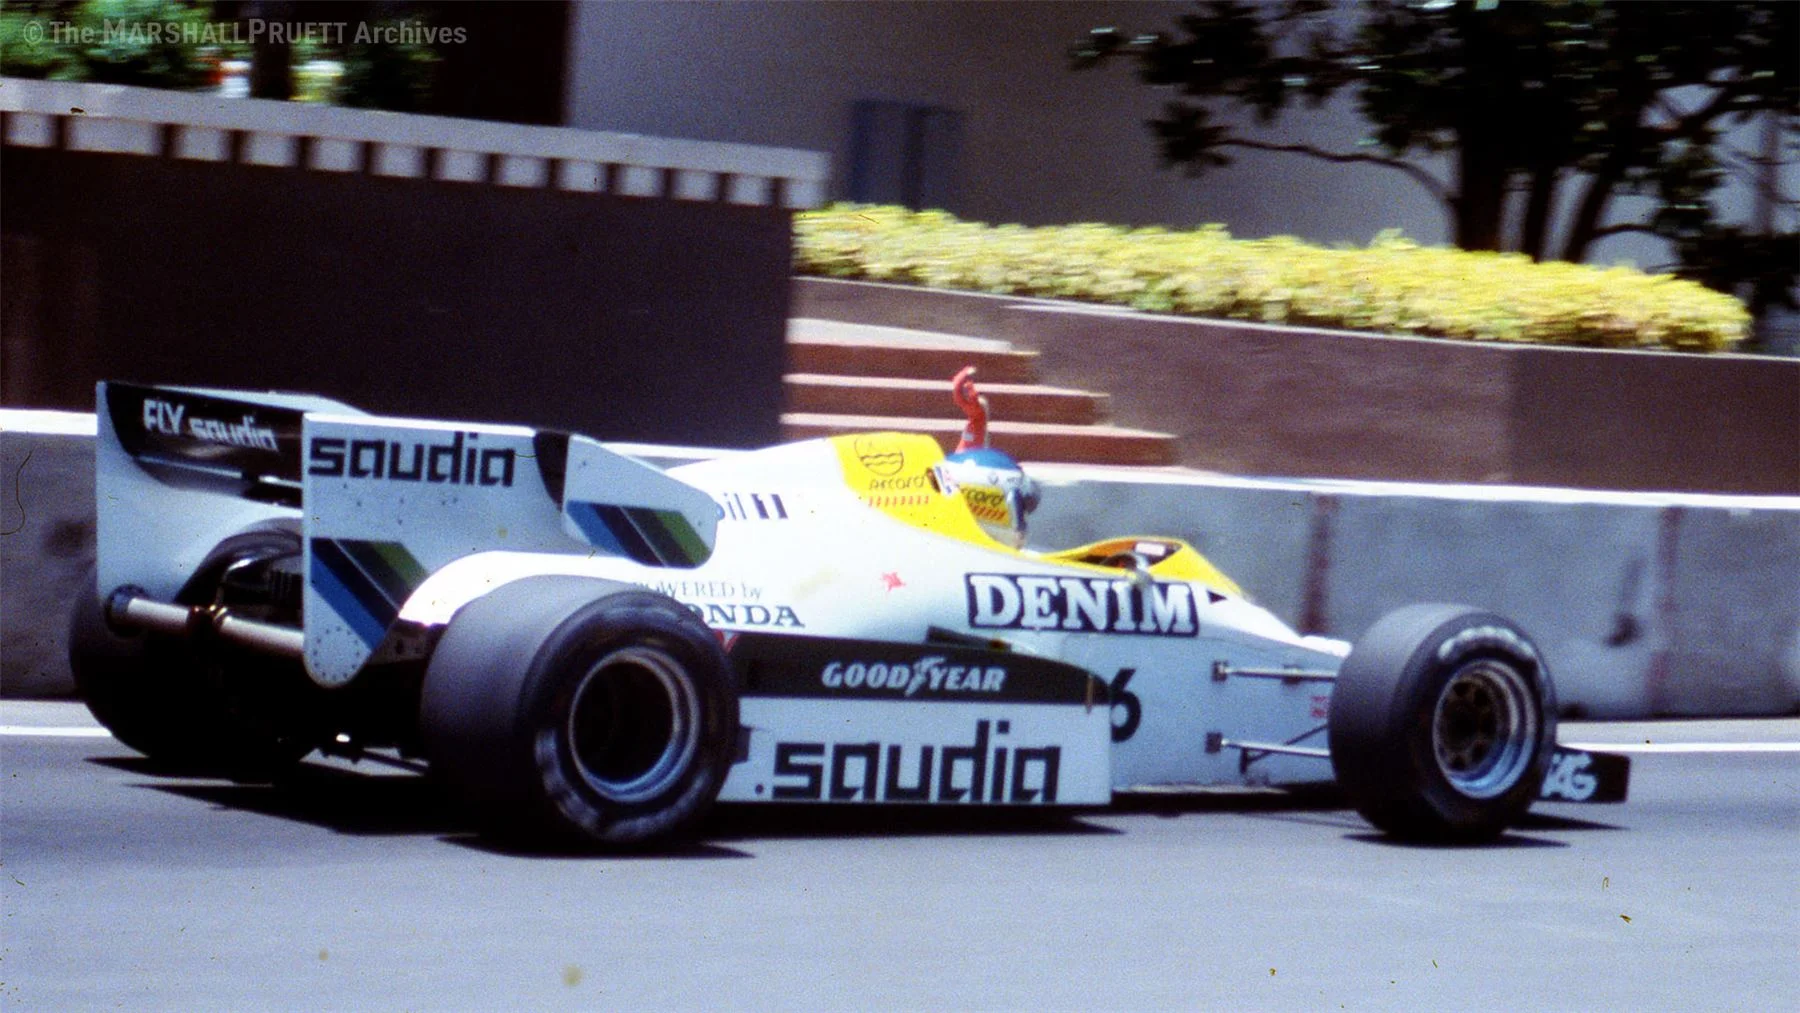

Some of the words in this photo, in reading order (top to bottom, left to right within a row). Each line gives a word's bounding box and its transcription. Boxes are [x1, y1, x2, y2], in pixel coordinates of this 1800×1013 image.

[143, 398, 184, 435] FLY
[188, 415, 279, 452] saudia
[308, 431, 516, 487] saudia
[683, 603, 805, 628] NDA
[968, 574, 1197, 635] DENIM
[1109, 668, 1141, 743] 6
[773, 719, 1060, 801] saudia
[1541, 752, 1597, 801] AG
